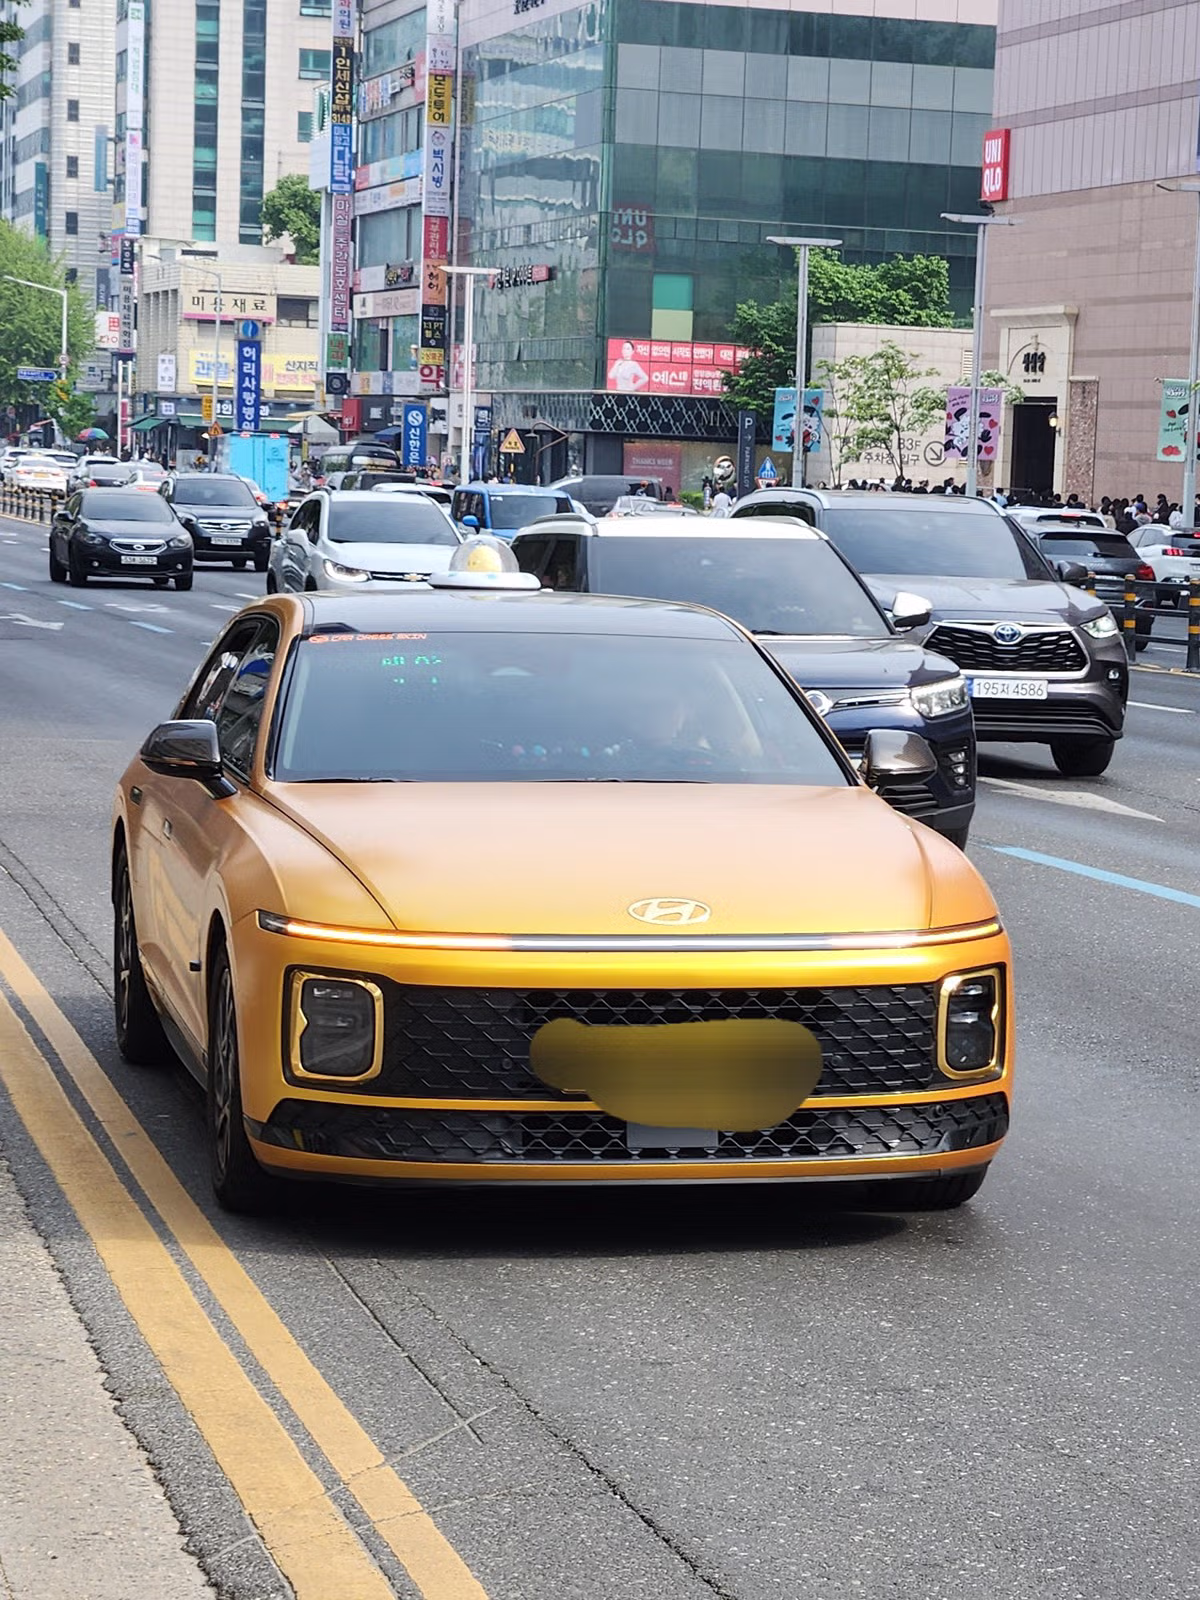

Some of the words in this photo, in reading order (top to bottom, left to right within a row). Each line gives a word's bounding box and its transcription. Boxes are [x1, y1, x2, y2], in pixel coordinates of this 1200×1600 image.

[985, 138, 1002, 163] UNI
[983, 167, 1002, 196] QLO
[192, 296, 268, 313] 미용재료
[433, 322, 444, 330] PT
[744, 417, 753, 429] P
[1012, 683, 1044, 696] 4586
